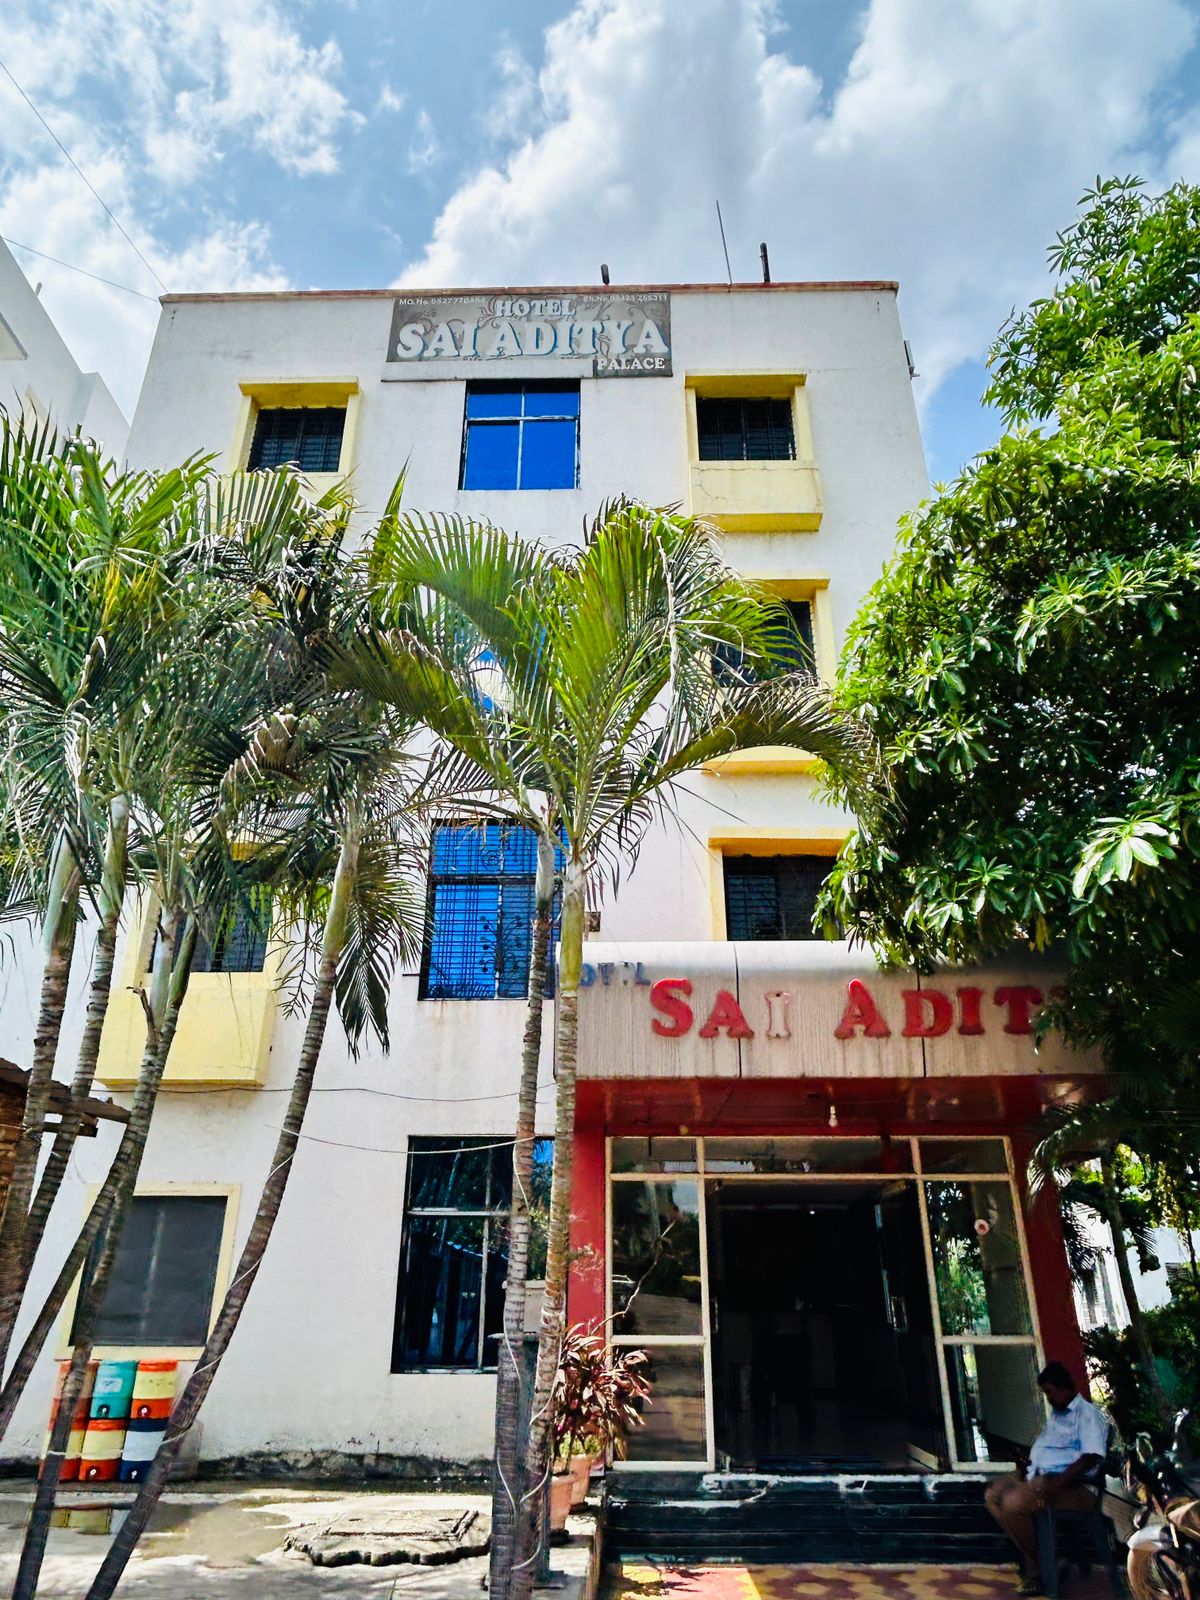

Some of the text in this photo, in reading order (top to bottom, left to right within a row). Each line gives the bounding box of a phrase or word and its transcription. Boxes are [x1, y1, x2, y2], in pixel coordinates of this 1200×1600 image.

[494, 299, 576, 317] HOTEL
[397, 319, 669, 358] SAI ADITYA
[597, 357, 665, 370] PALACE
[650, 977, 1066, 1040] SAI ADIT
